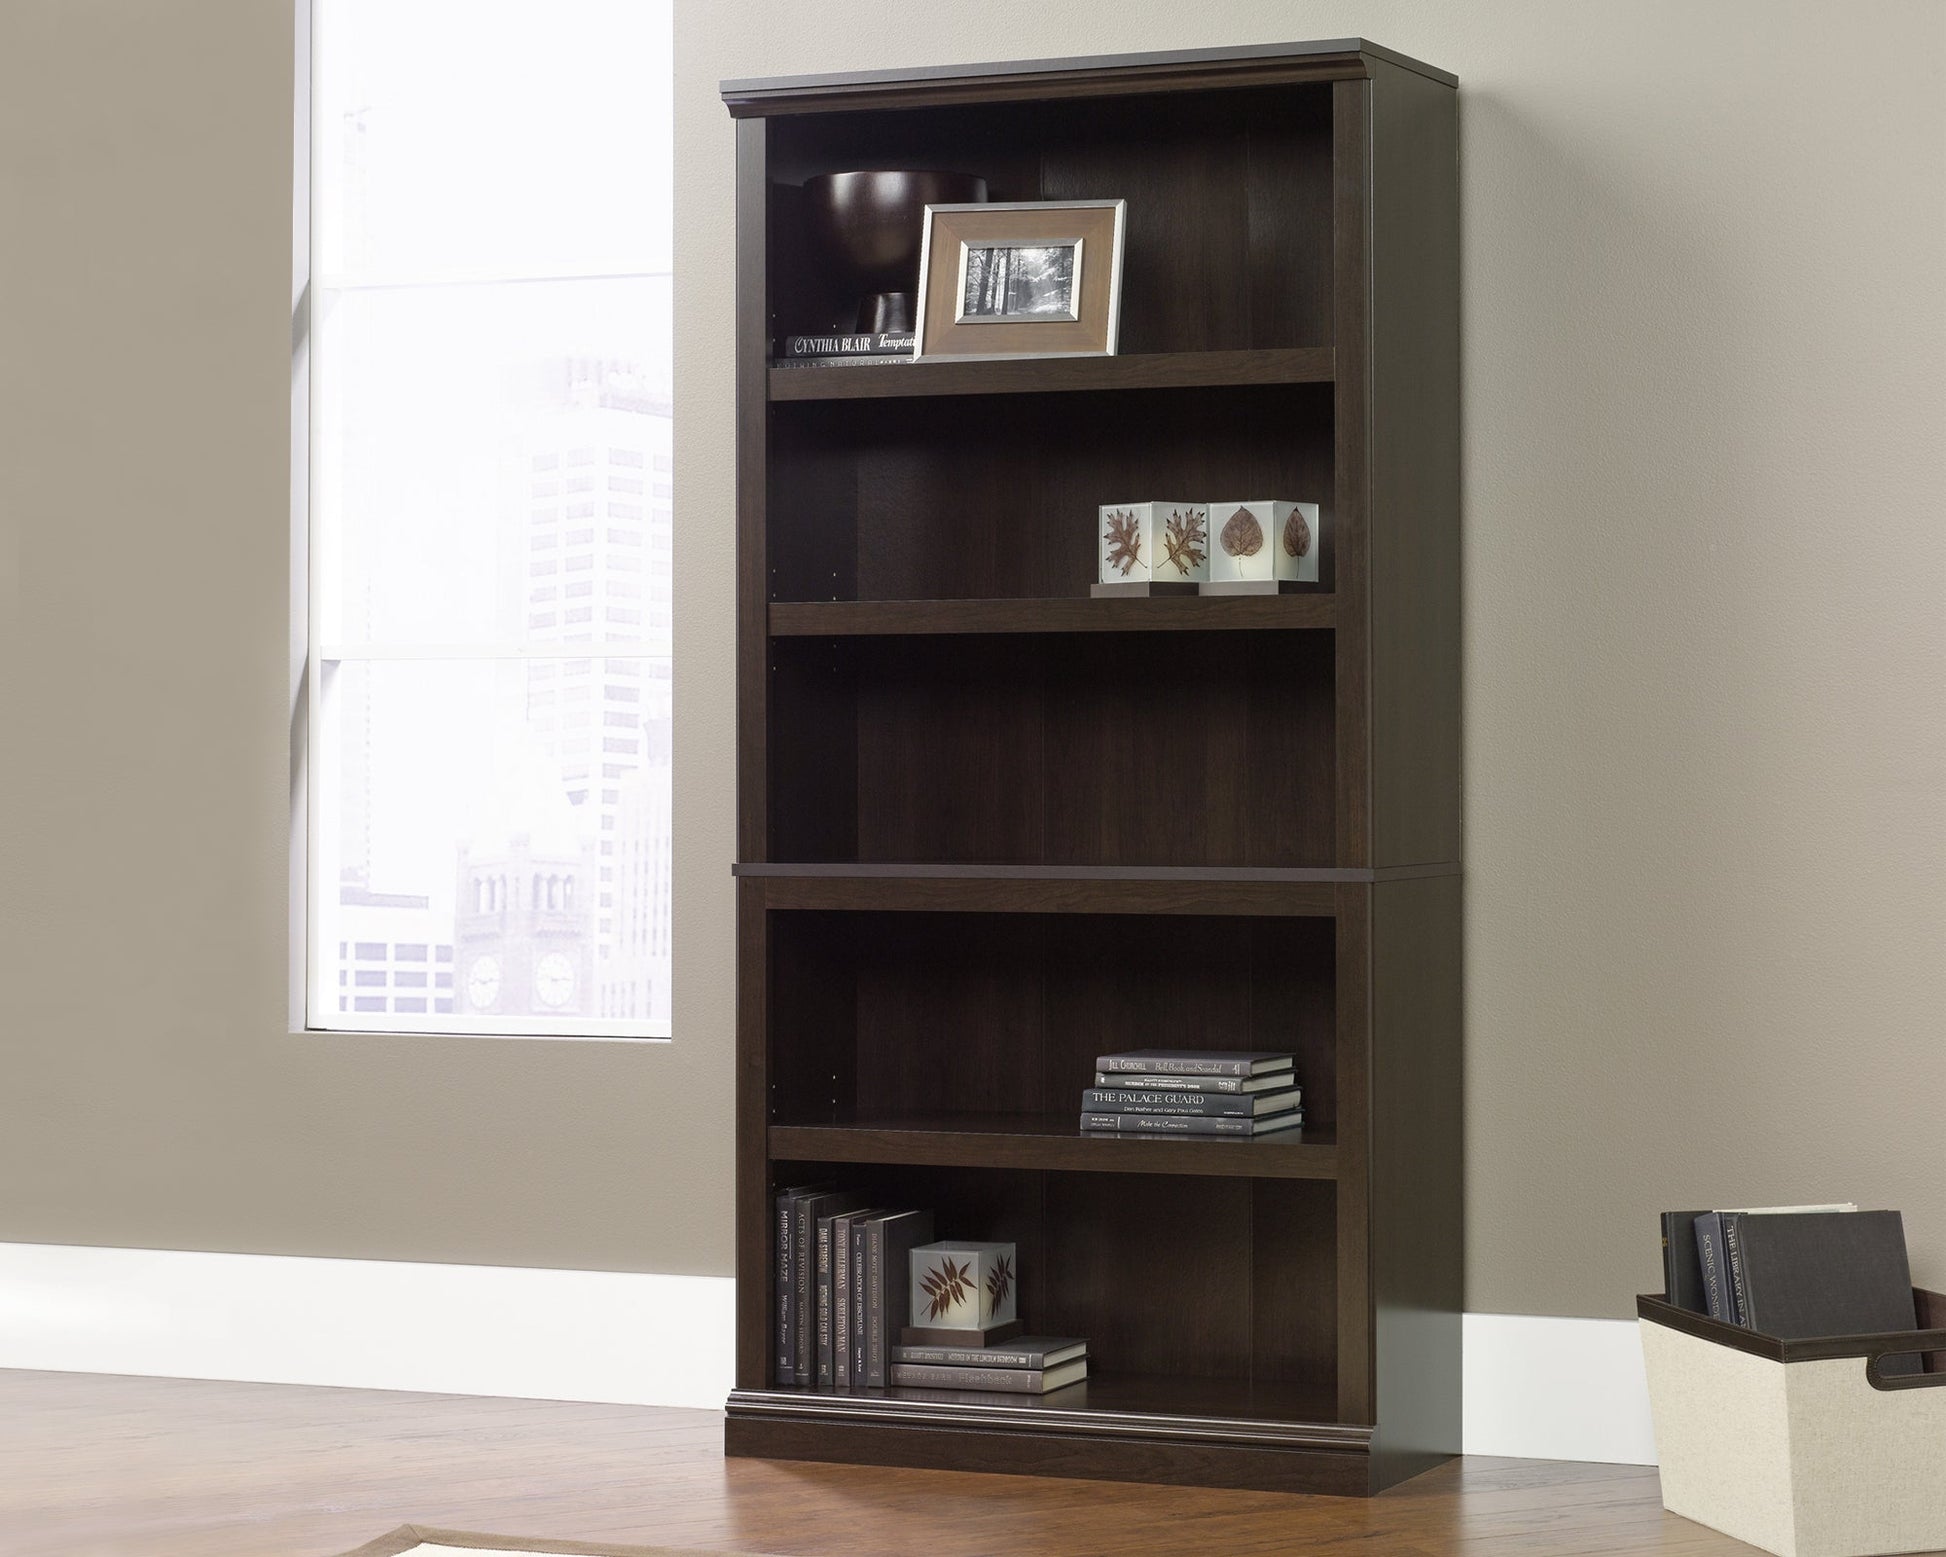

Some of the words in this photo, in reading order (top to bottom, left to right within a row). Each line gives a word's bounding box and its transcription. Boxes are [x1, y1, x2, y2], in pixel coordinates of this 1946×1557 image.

[794, 336, 839, 353] CYNTHIA
[841, 337, 871, 352] BLAIR
[1092, 1092, 1116, 1102] THE
[1119, 1093, 1163, 1104] PALACE
[1164, 1094, 1205, 1105] GUARD
[780, 1210, 788, 1250] MIRROR
[798, 1212, 806, 1234] ACTS
[1726, 1225, 1736, 1249] THE
[1703, 1234, 1716, 1273] SCENIC
[780, 1253, 788, 1282] MAZE
[798, 1251, 806, 1293] REVISION
[1730, 1250, 1743, 1297] LIBRARY
[837, 1297, 846, 1335] SKELETON
[1737, 1299, 1745, 1312] IN
[837, 1336, 846, 1353] MAN
